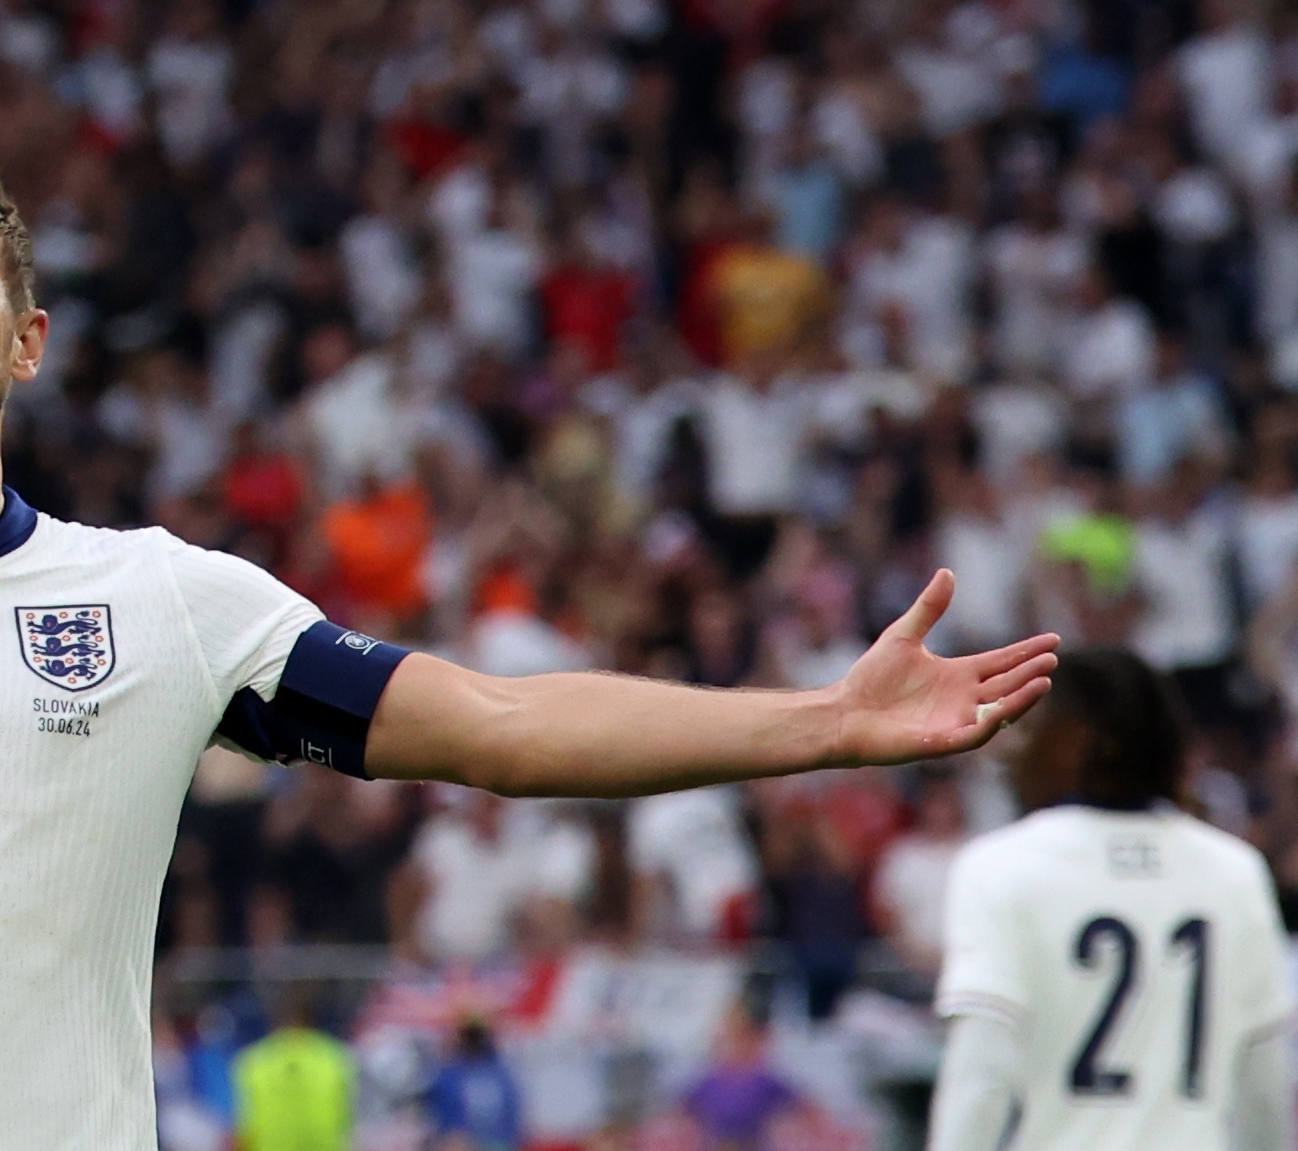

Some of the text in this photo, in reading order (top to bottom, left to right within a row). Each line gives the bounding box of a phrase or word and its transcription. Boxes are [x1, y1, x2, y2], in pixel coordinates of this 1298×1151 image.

[33, 698, 100, 717] SLOVAKIA
[37, 717, 91, 737] 30.06.24
[1068, 916, 1211, 1098] 21
